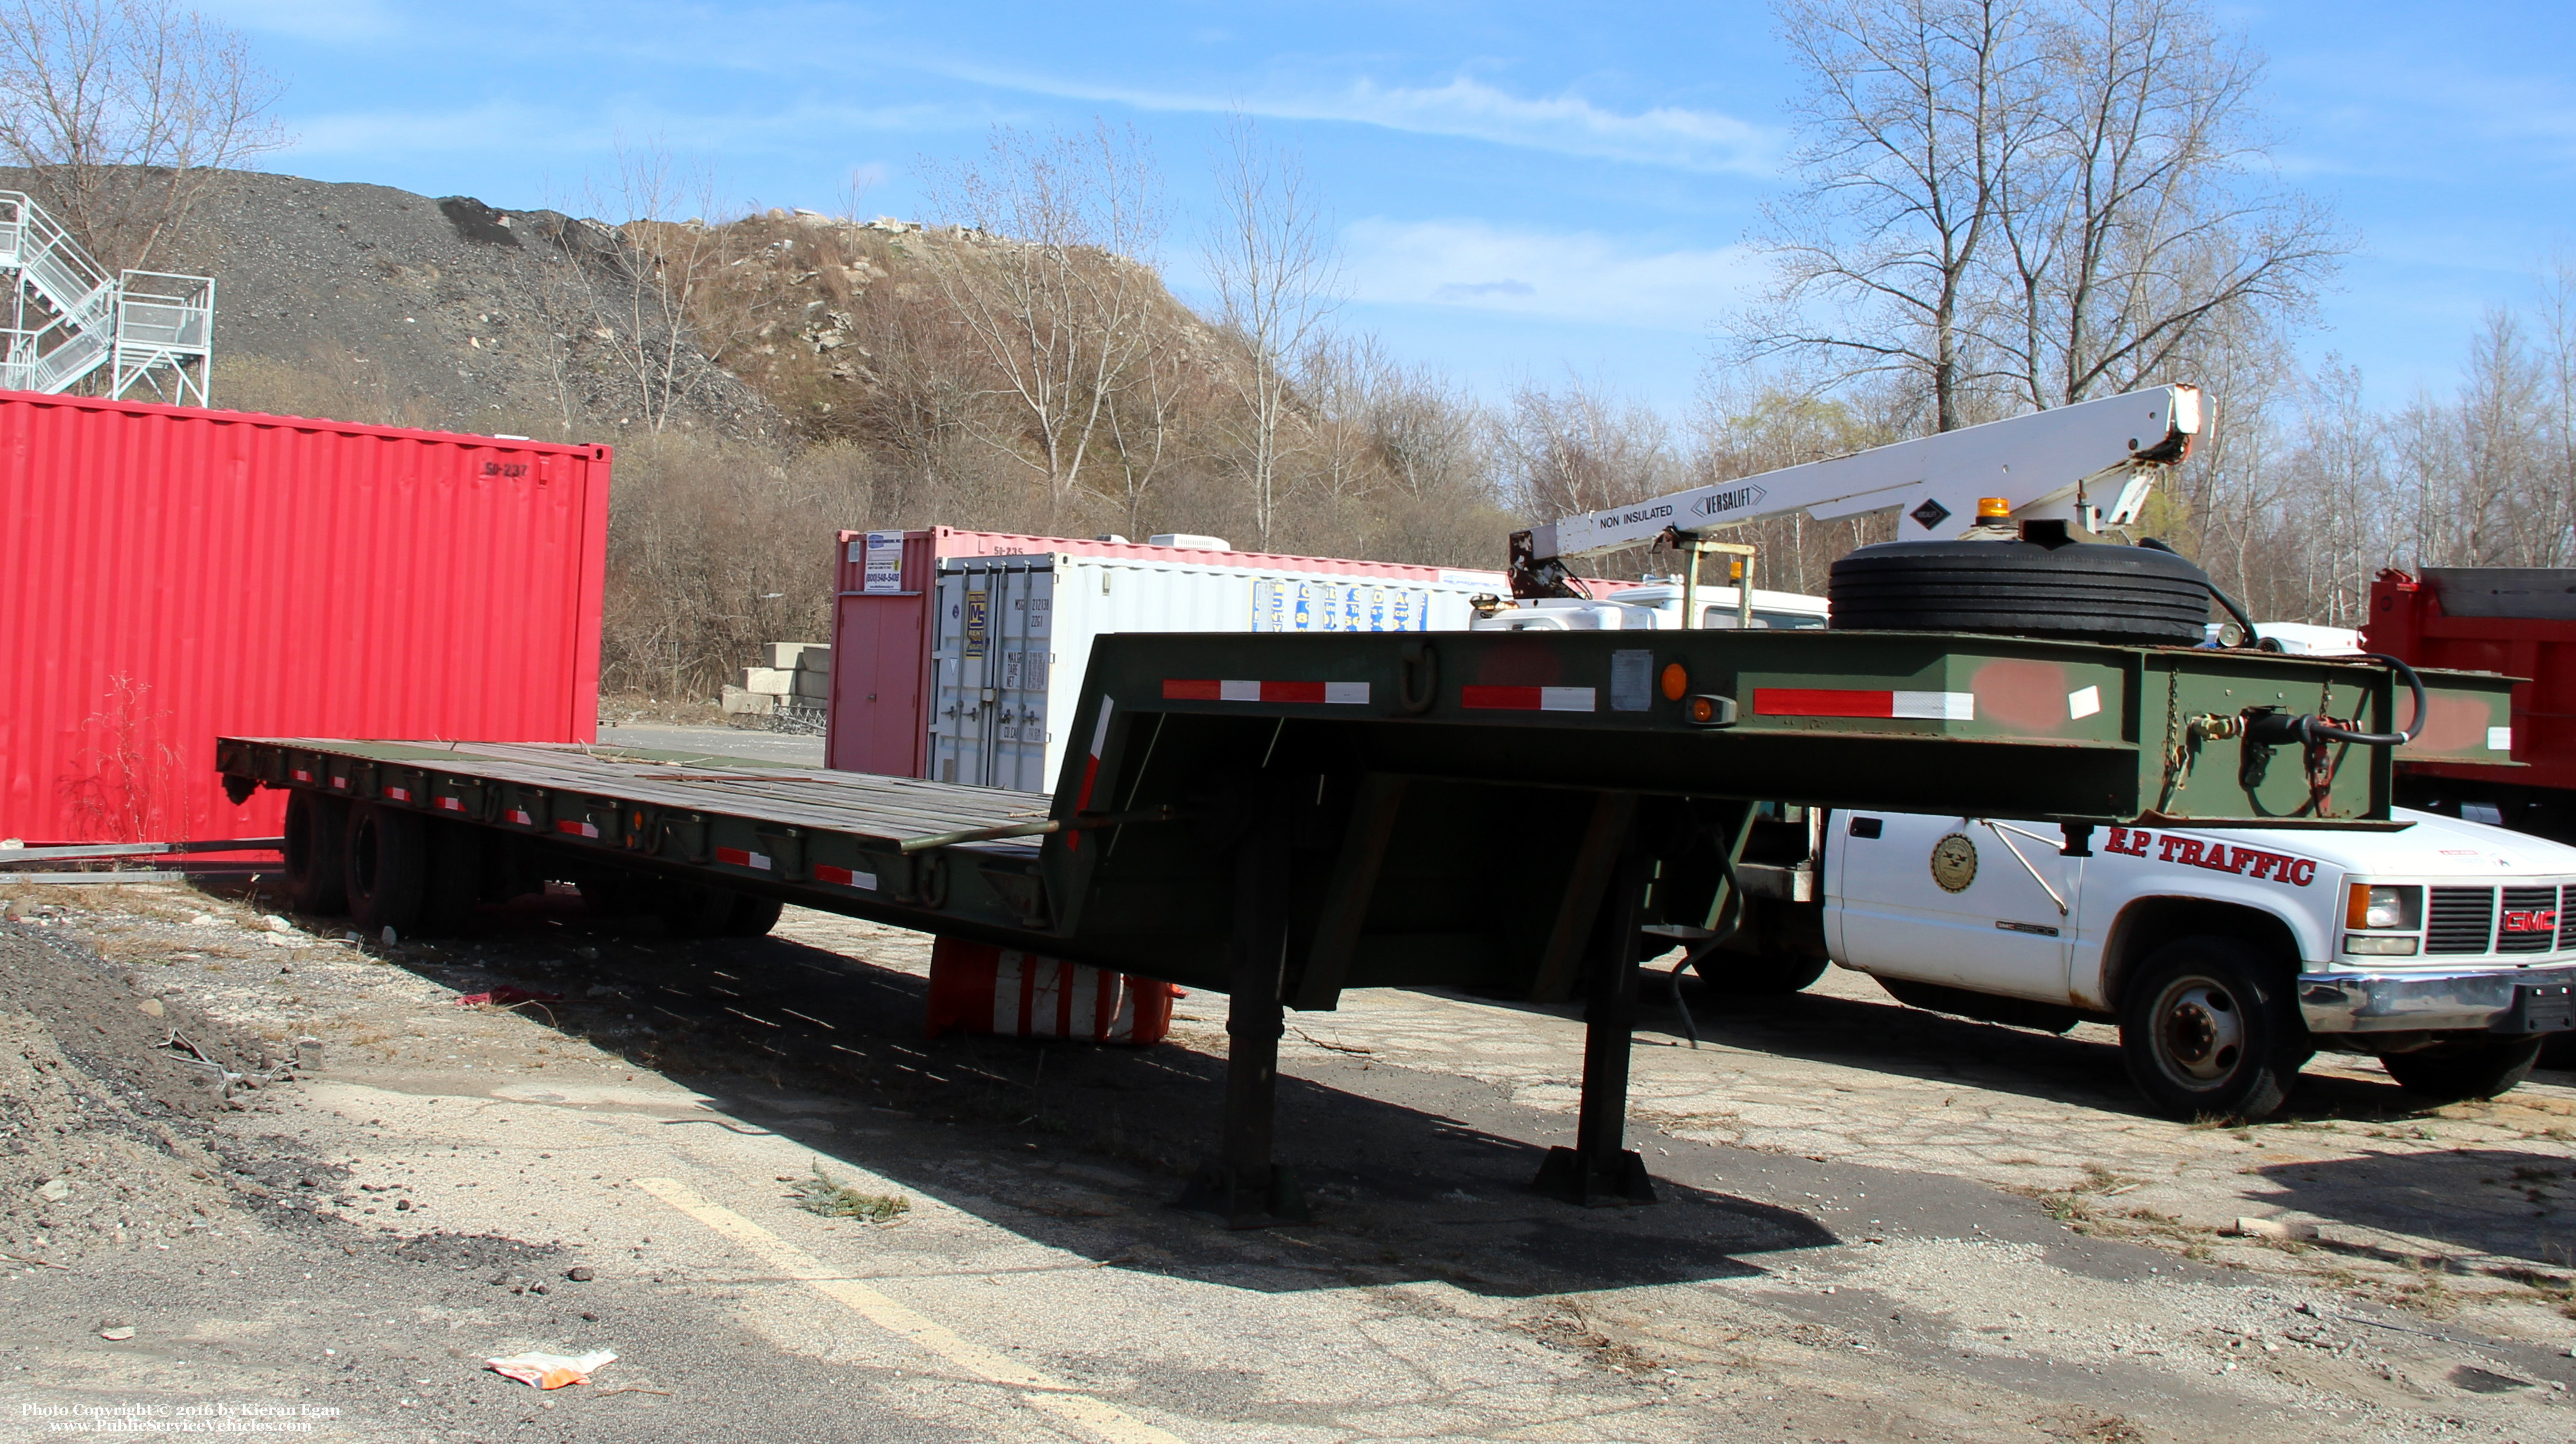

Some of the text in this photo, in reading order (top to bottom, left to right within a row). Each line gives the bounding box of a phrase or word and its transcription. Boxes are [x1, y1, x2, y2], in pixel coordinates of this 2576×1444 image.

[1705, 488, 1751, 514] VERSALIFT
[1600, 505, 1673, 529] NON INSULATED
[1008, 664, 1018, 676] TARE
[2104, 827, 2317, 887] E.P. TRAFFIC
[2505, 910, 2557, 931] GMC
